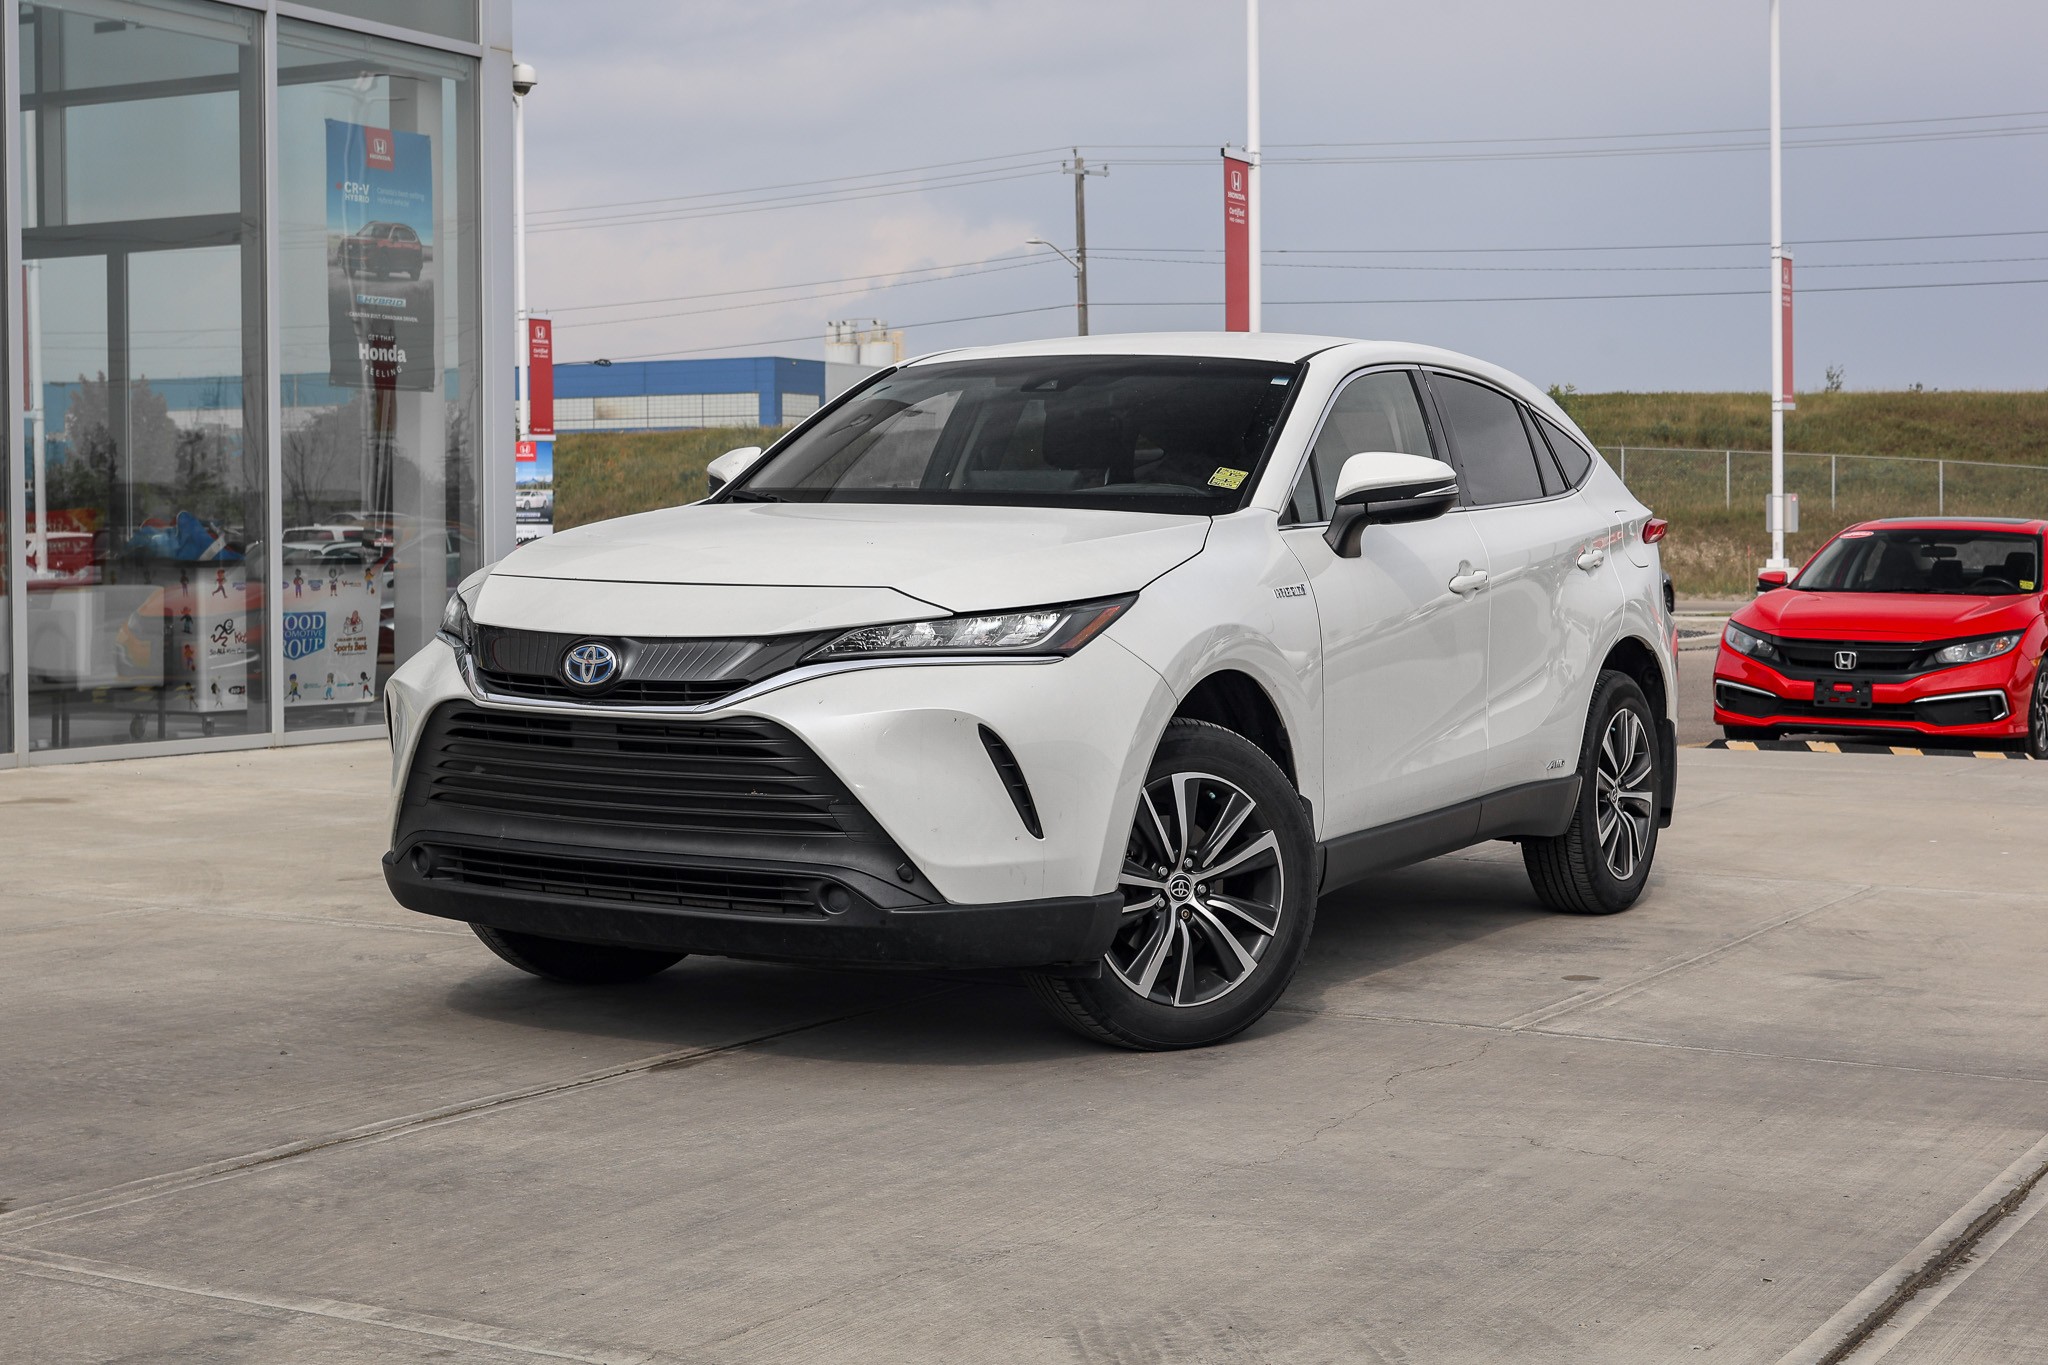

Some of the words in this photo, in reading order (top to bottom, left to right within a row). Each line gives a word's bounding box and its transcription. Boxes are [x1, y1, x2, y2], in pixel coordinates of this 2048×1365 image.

[369, 153, 392, 162] HONDA
[344, 181, 370, 195] CR-V
[344, 194, 370, 204] HYBRID
[1228, 191, 1246, 201] HONDA
[368, 333, 379, 341] GET
[380, 334, 394, 342] THAT
[359, 343, 407, 362] Honda
[365, 364, 402, 378] FEELING
[284, 614, 324, 631] OOD
[284, 630, 323, 638] OMOTIVE
